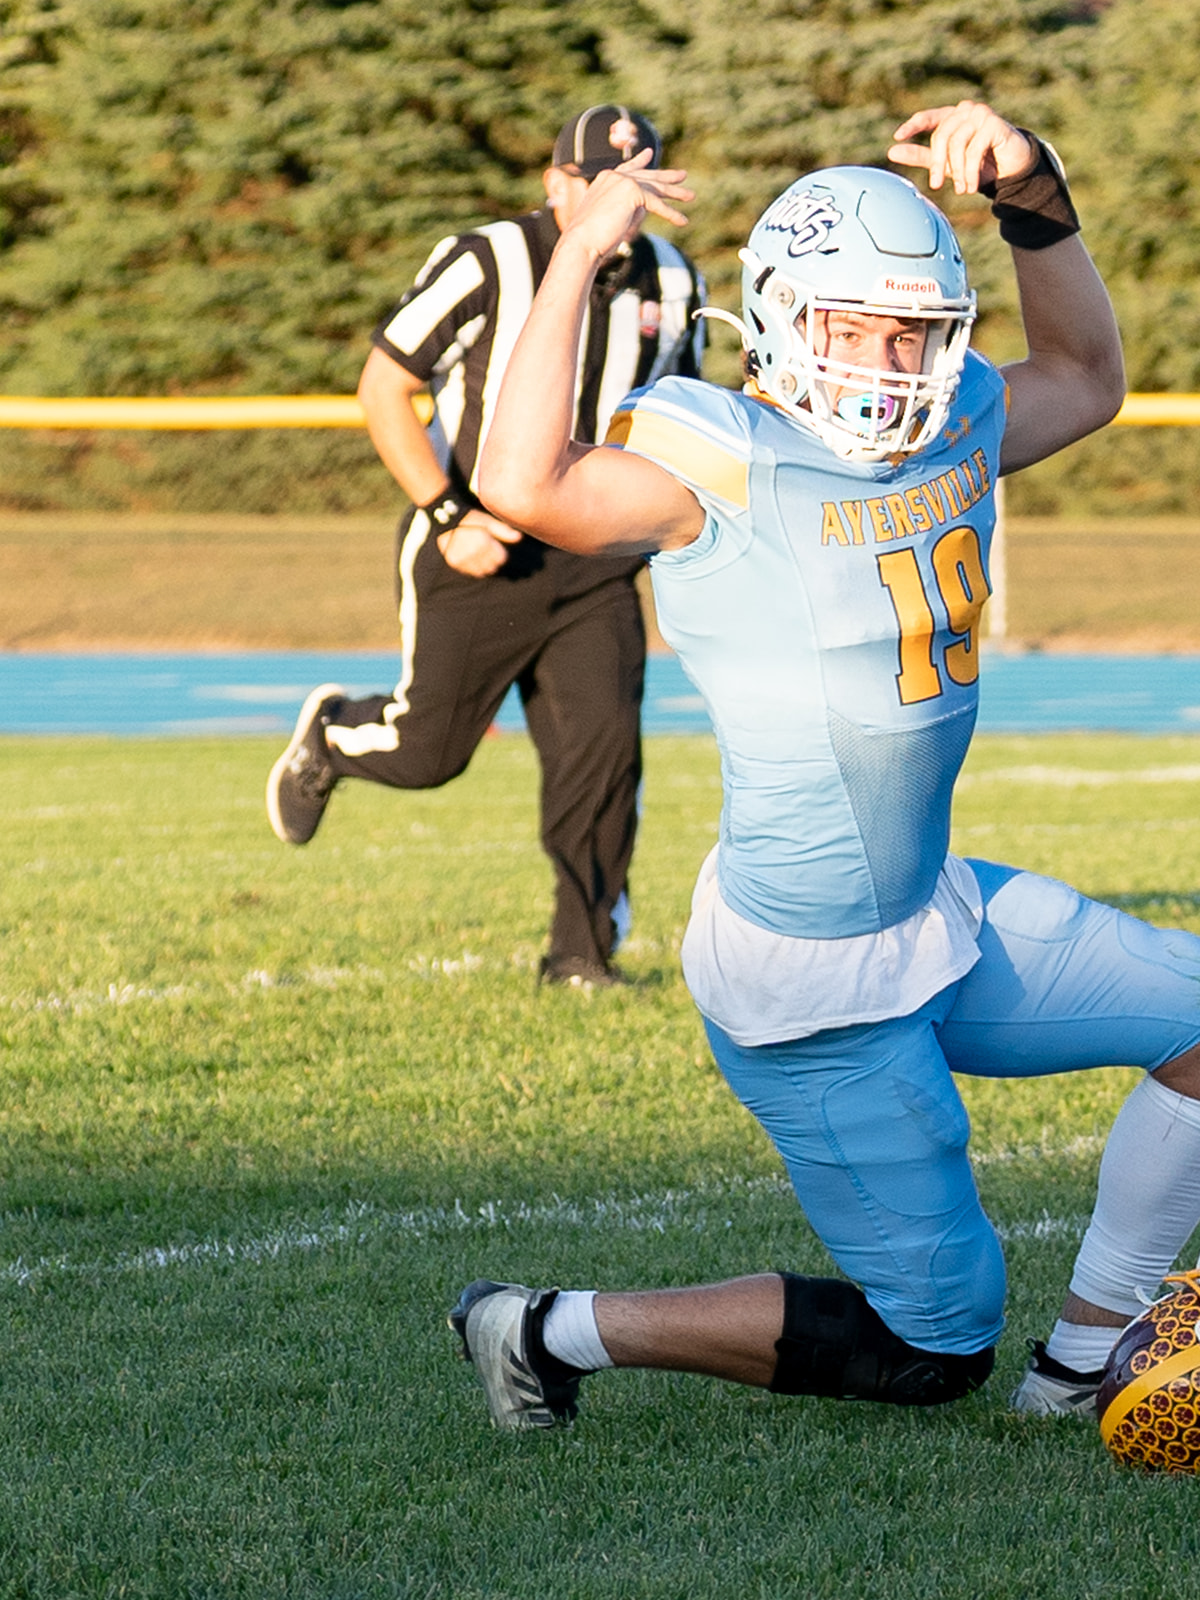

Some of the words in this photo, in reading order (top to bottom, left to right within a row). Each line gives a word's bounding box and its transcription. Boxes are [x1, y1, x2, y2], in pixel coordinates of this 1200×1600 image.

[885, 278, 936, 293] Riddell
[820, 446, 991, 547] AYERSVILLE
[875, 524, 993, 706] 19
